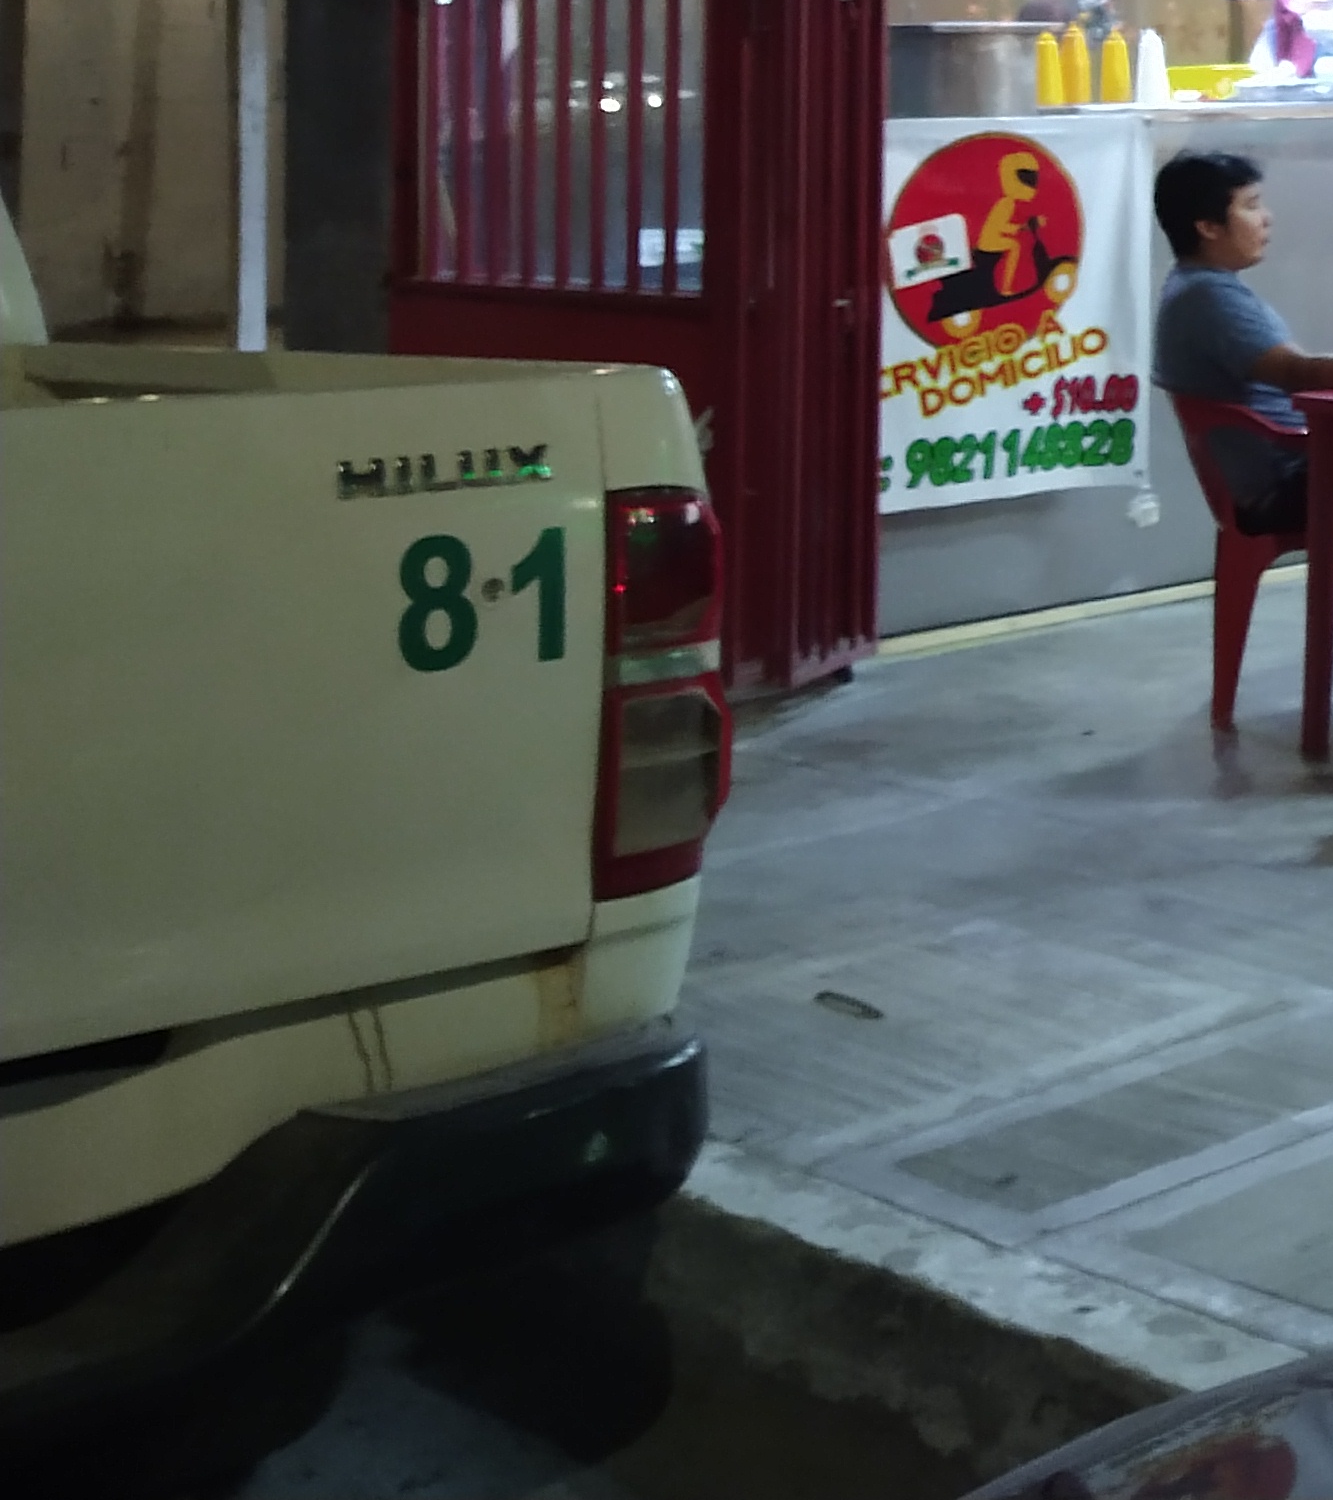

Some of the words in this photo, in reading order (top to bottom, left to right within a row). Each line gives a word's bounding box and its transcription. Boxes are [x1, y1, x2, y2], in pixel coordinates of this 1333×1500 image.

[878, 323, 1028, 400] ERVICIO
[919, 328, 1108, 419] DOMICILIO
[336, 443, 554, 500] HILUX
